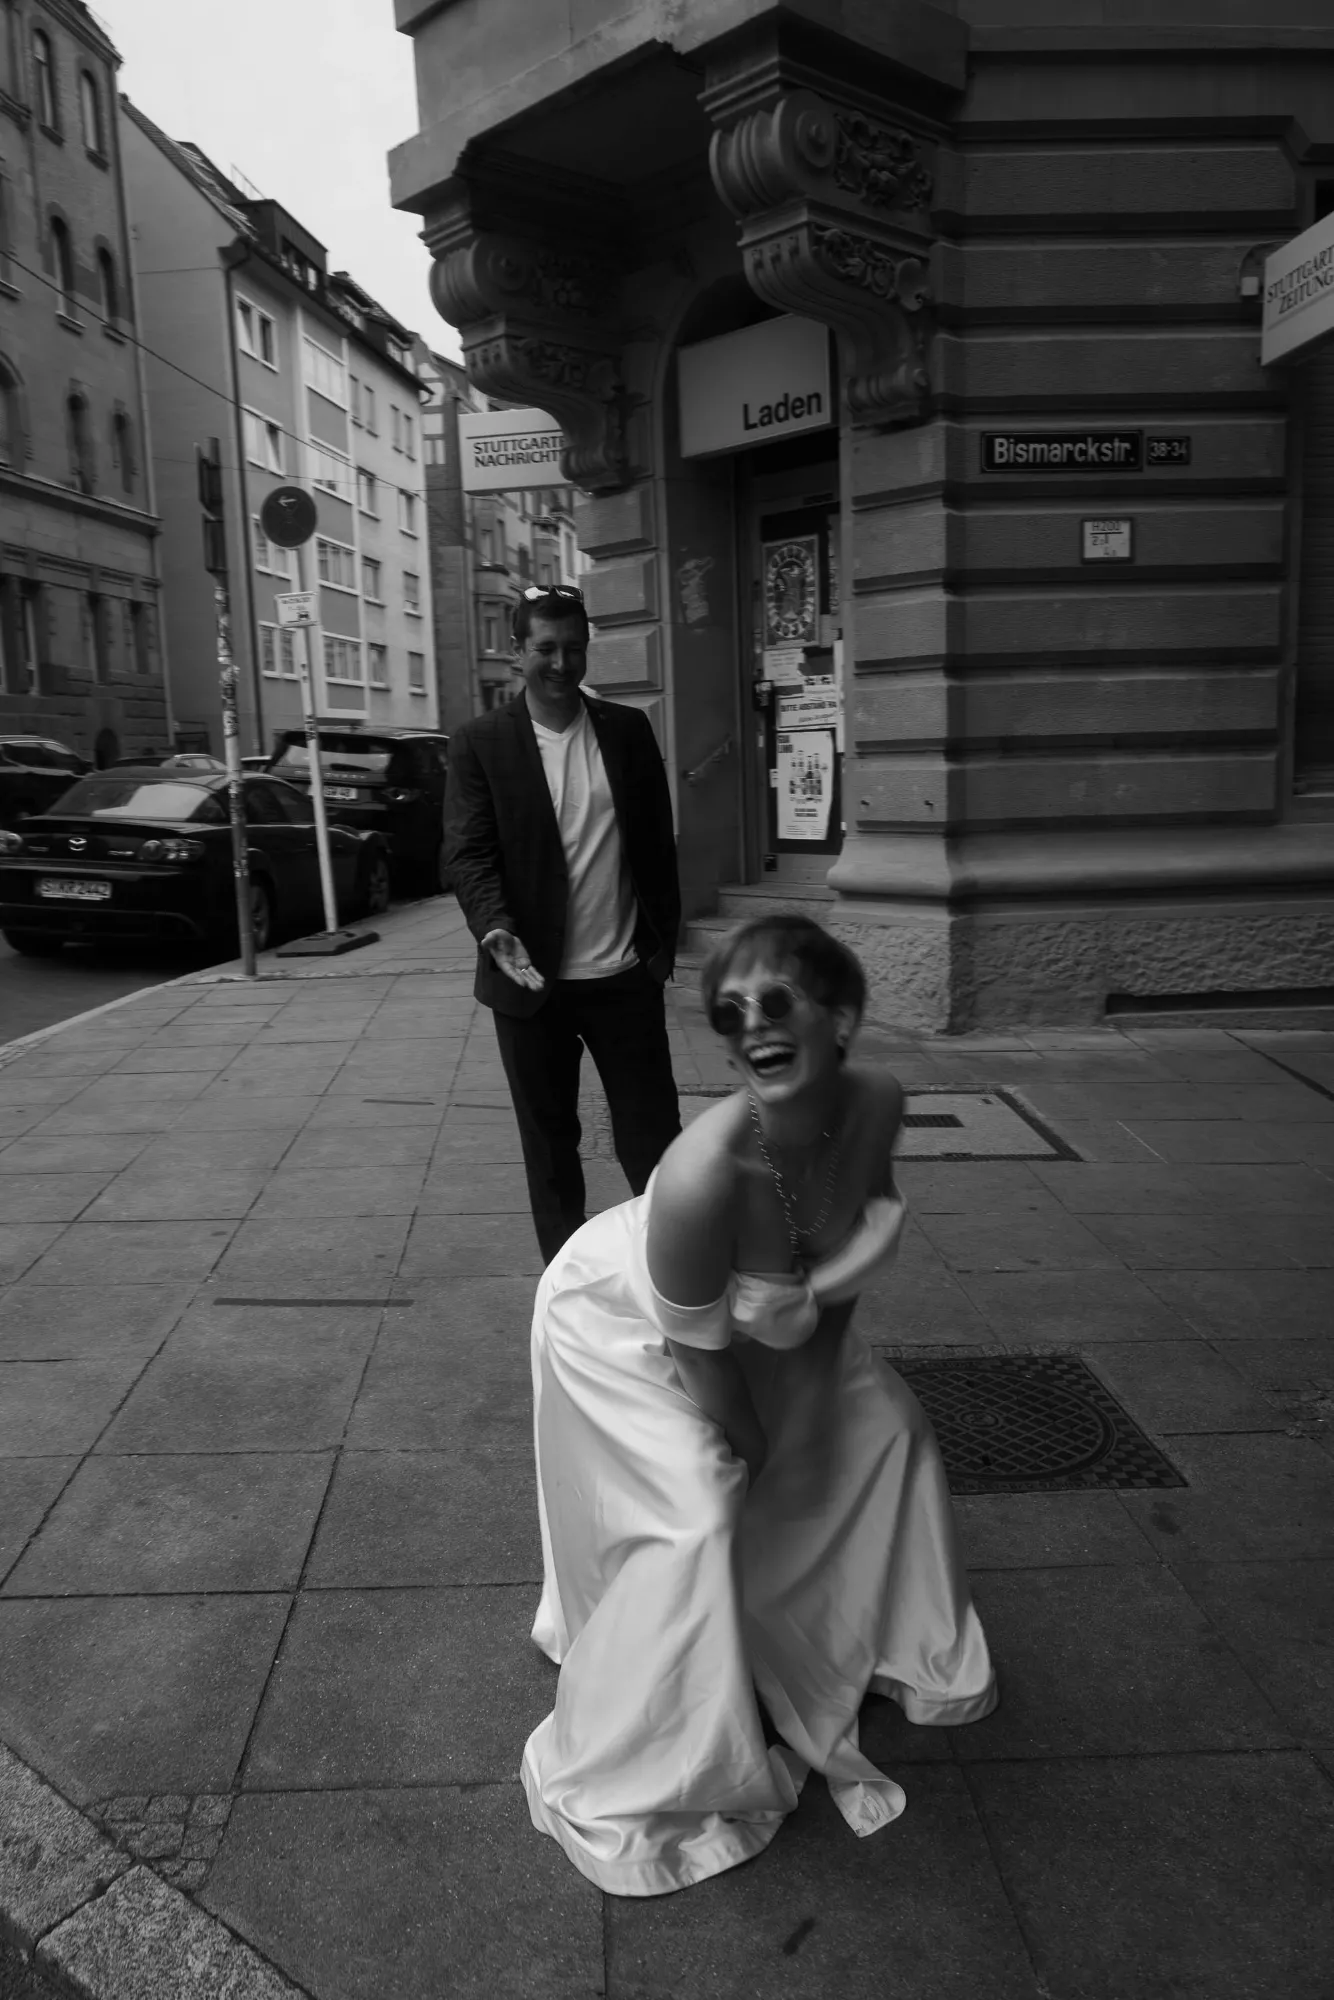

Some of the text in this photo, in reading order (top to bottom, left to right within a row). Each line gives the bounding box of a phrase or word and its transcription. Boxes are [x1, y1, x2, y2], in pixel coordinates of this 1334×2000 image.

[1278, 267, 1334, 315] ZEITUNG
[743, 392, 822, 431] Laden
[993, 436, 1136, 464] Bismarckstr.
[1150, 441, 1187, 457] 38-34
[780, 704, 798, 713] BITTE
